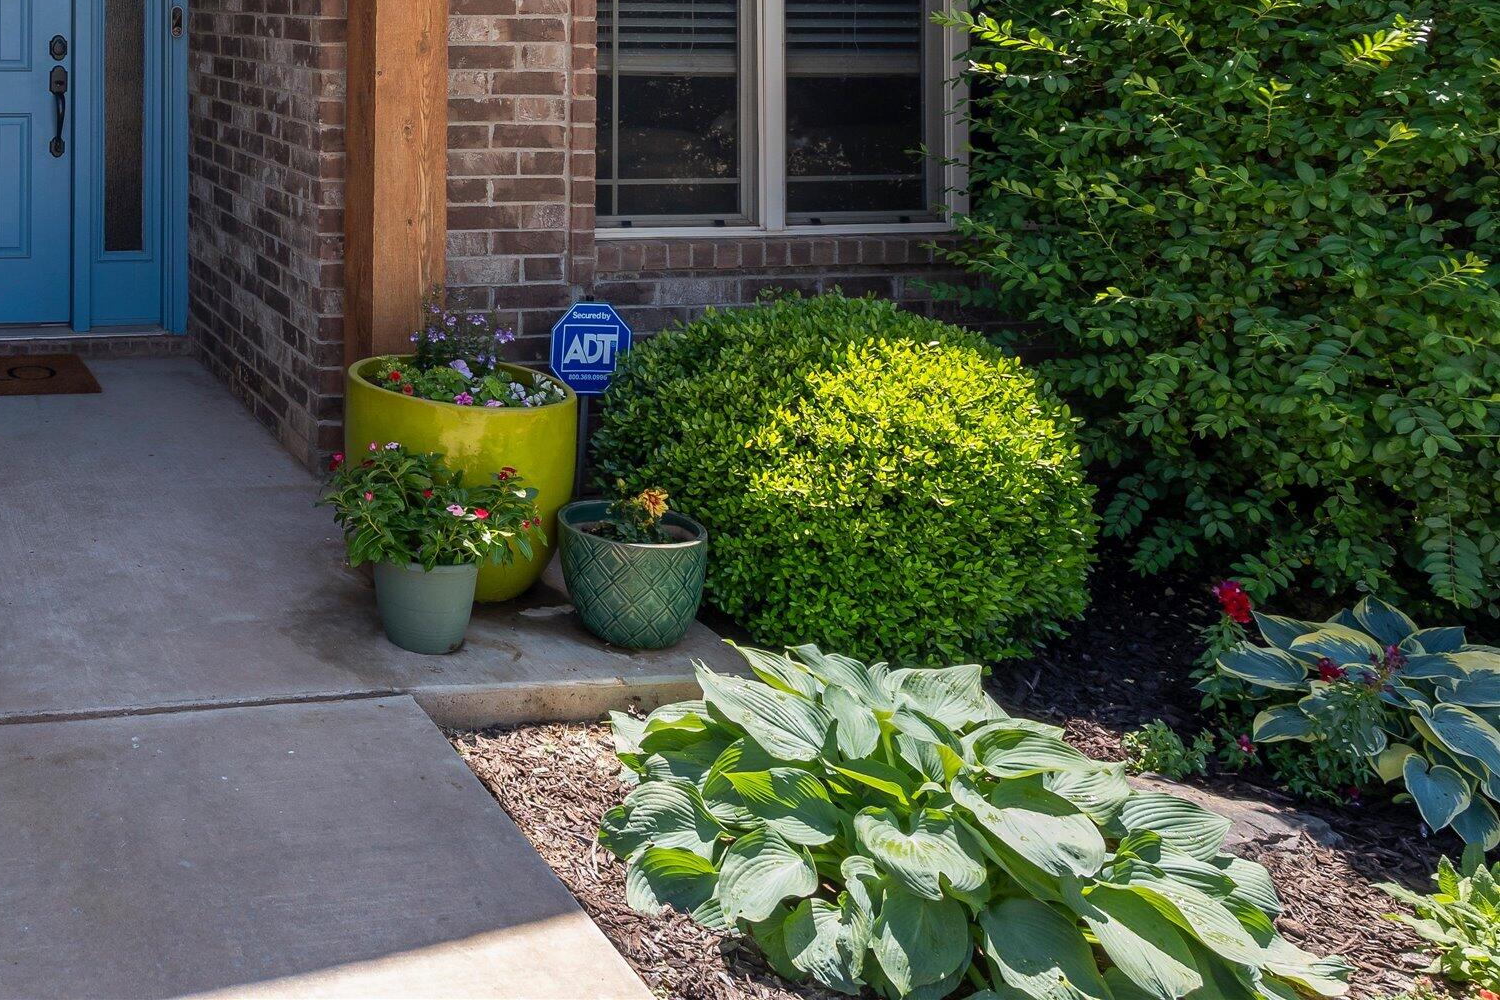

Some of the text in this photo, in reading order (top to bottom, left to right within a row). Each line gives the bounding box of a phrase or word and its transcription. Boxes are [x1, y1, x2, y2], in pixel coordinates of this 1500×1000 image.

[572, 311, 611, 321] Secured by
[563, 333, 618, 365] ADT
